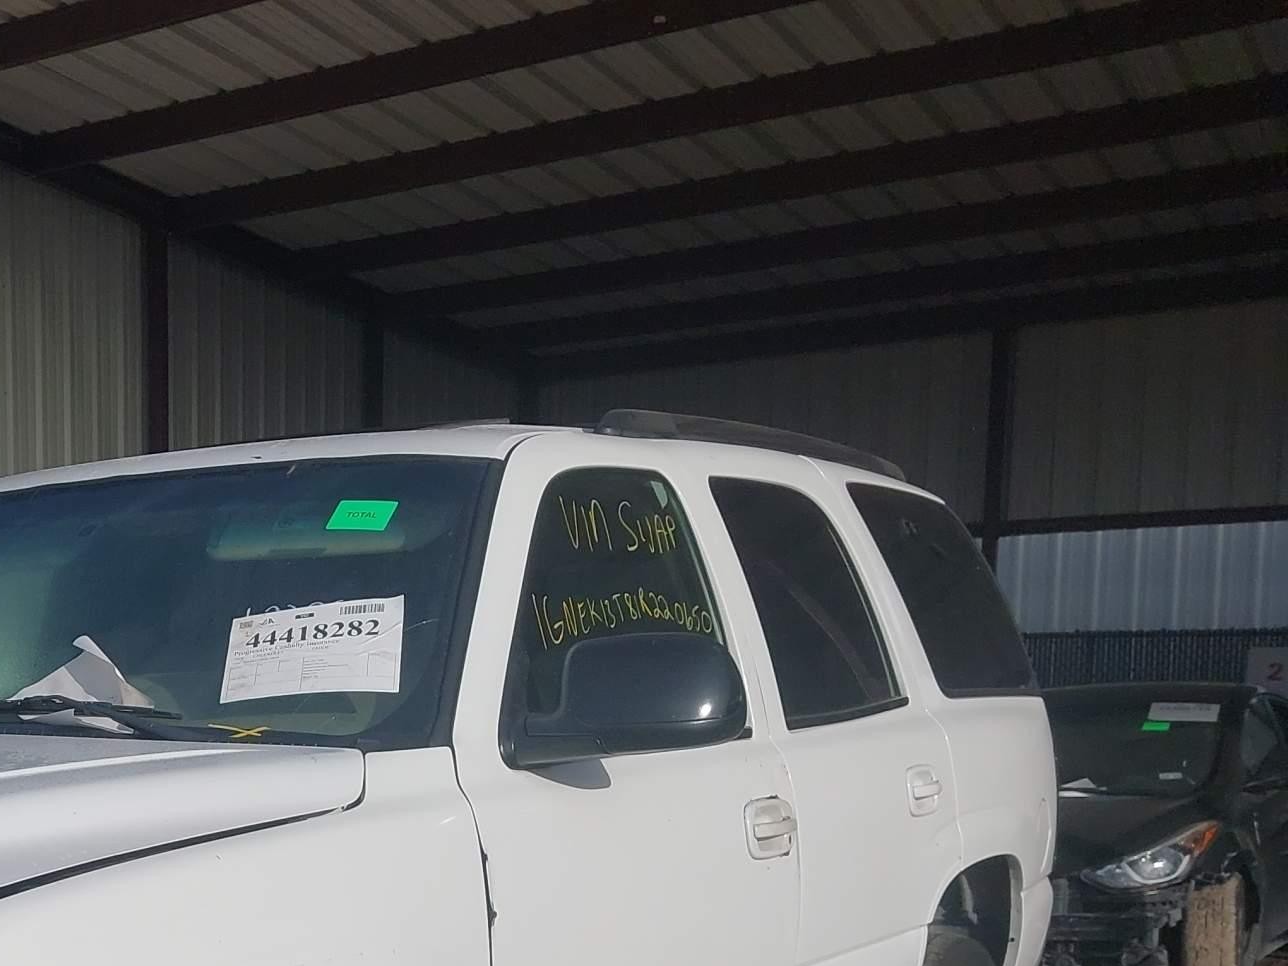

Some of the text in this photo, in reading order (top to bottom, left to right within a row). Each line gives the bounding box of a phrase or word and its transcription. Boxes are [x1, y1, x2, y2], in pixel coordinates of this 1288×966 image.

[346, 511, 376, 519] TOTAL
[559, 496, 676, 553] VIN SWAP
[245, 619, 380, 648] 44418282
